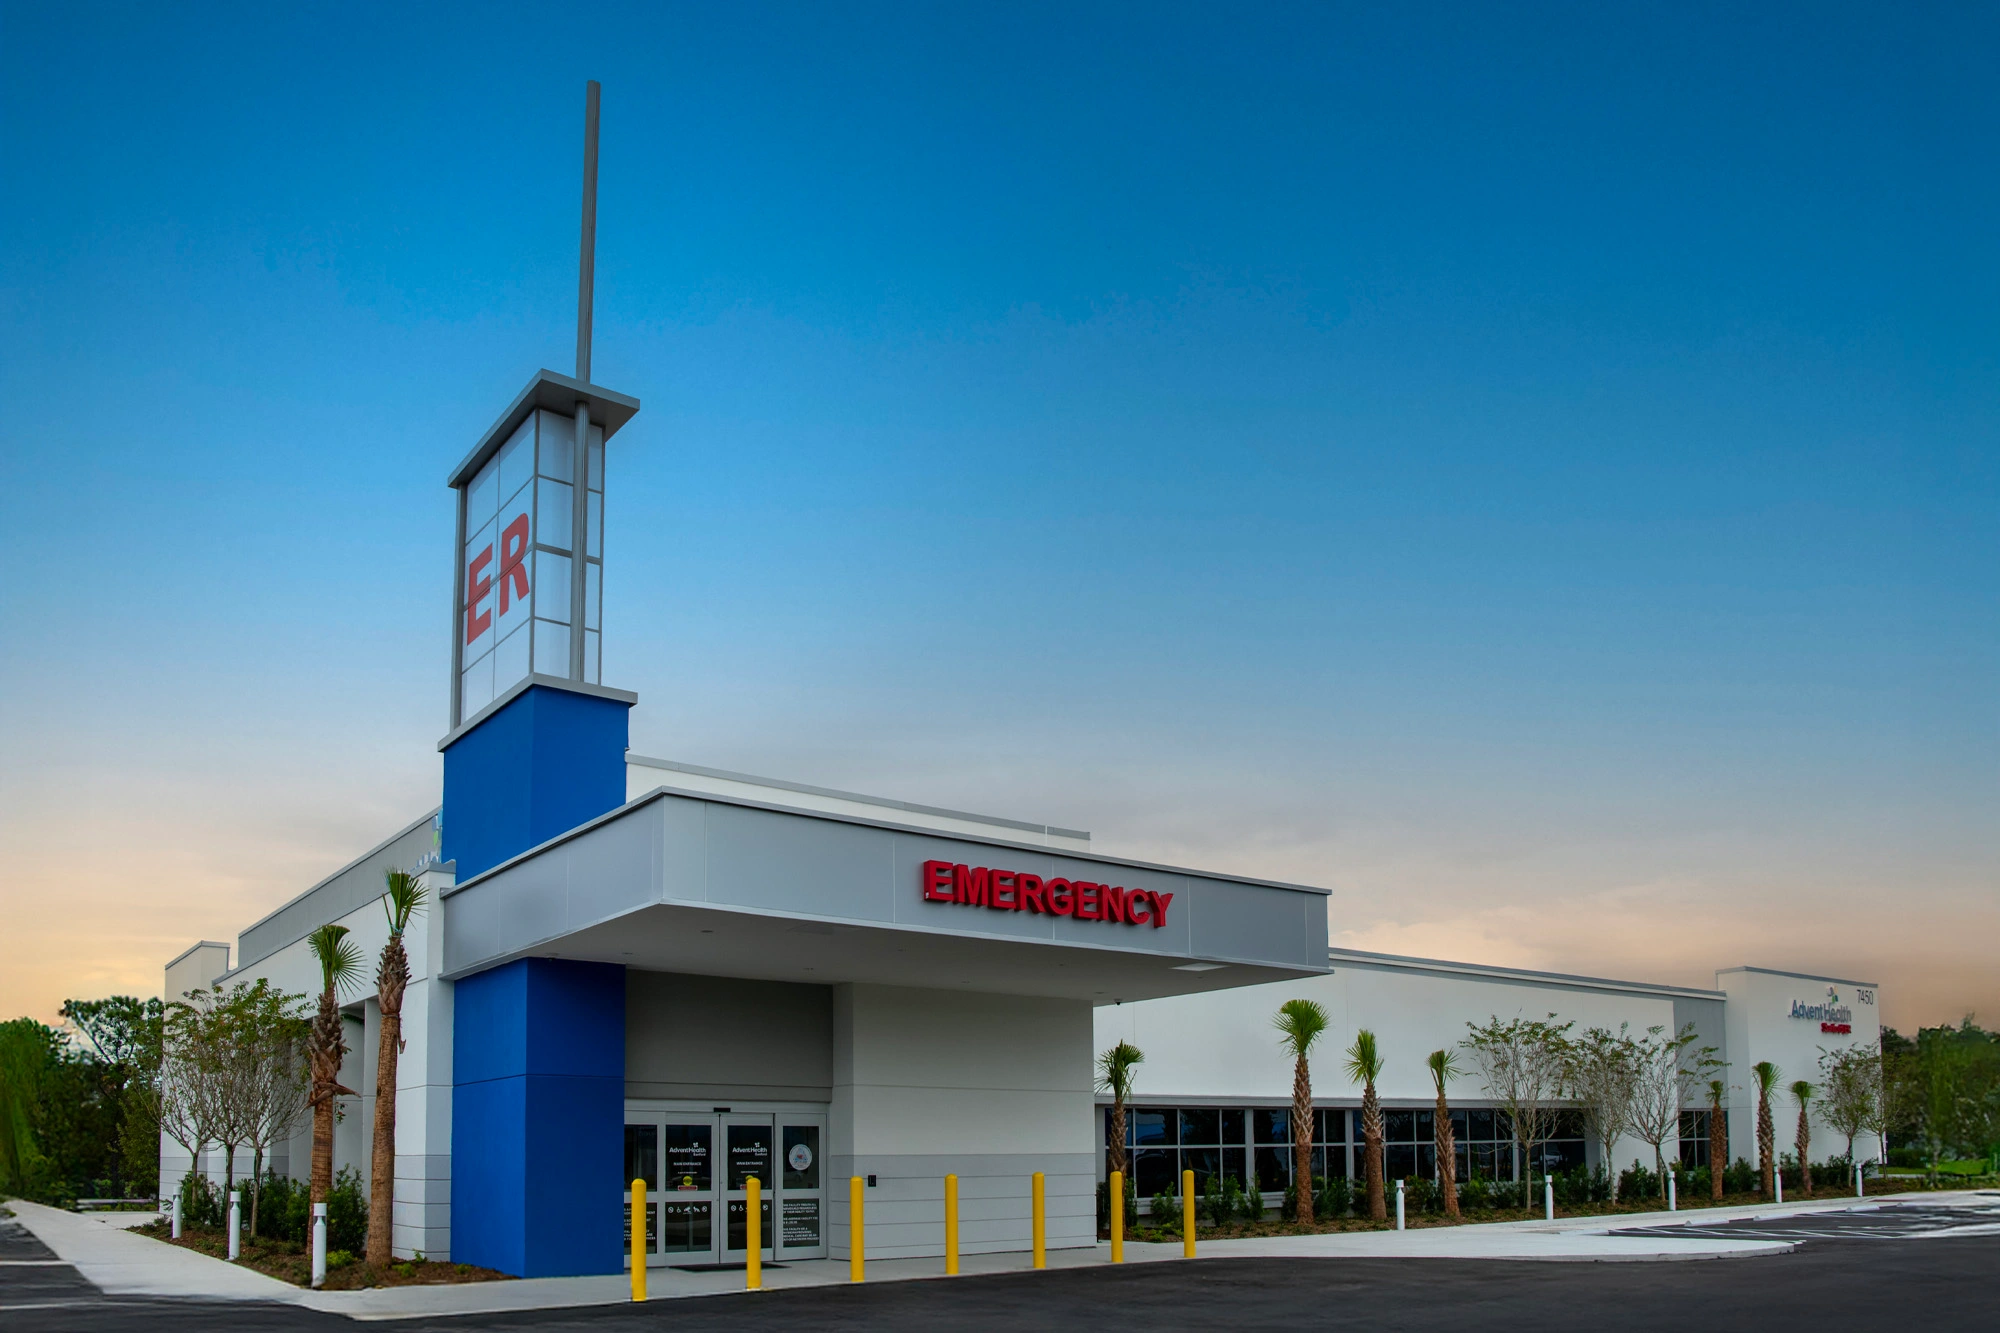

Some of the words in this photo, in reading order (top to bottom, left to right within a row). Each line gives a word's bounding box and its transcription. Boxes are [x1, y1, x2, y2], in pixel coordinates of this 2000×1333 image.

[467, 512, 530, 646] ER
[923, 859, 1174, 928] EMERGENCY
[1791, 999, 1852, 1022] AdventHealth
[1856, 989, 1874, 1005] 7450
